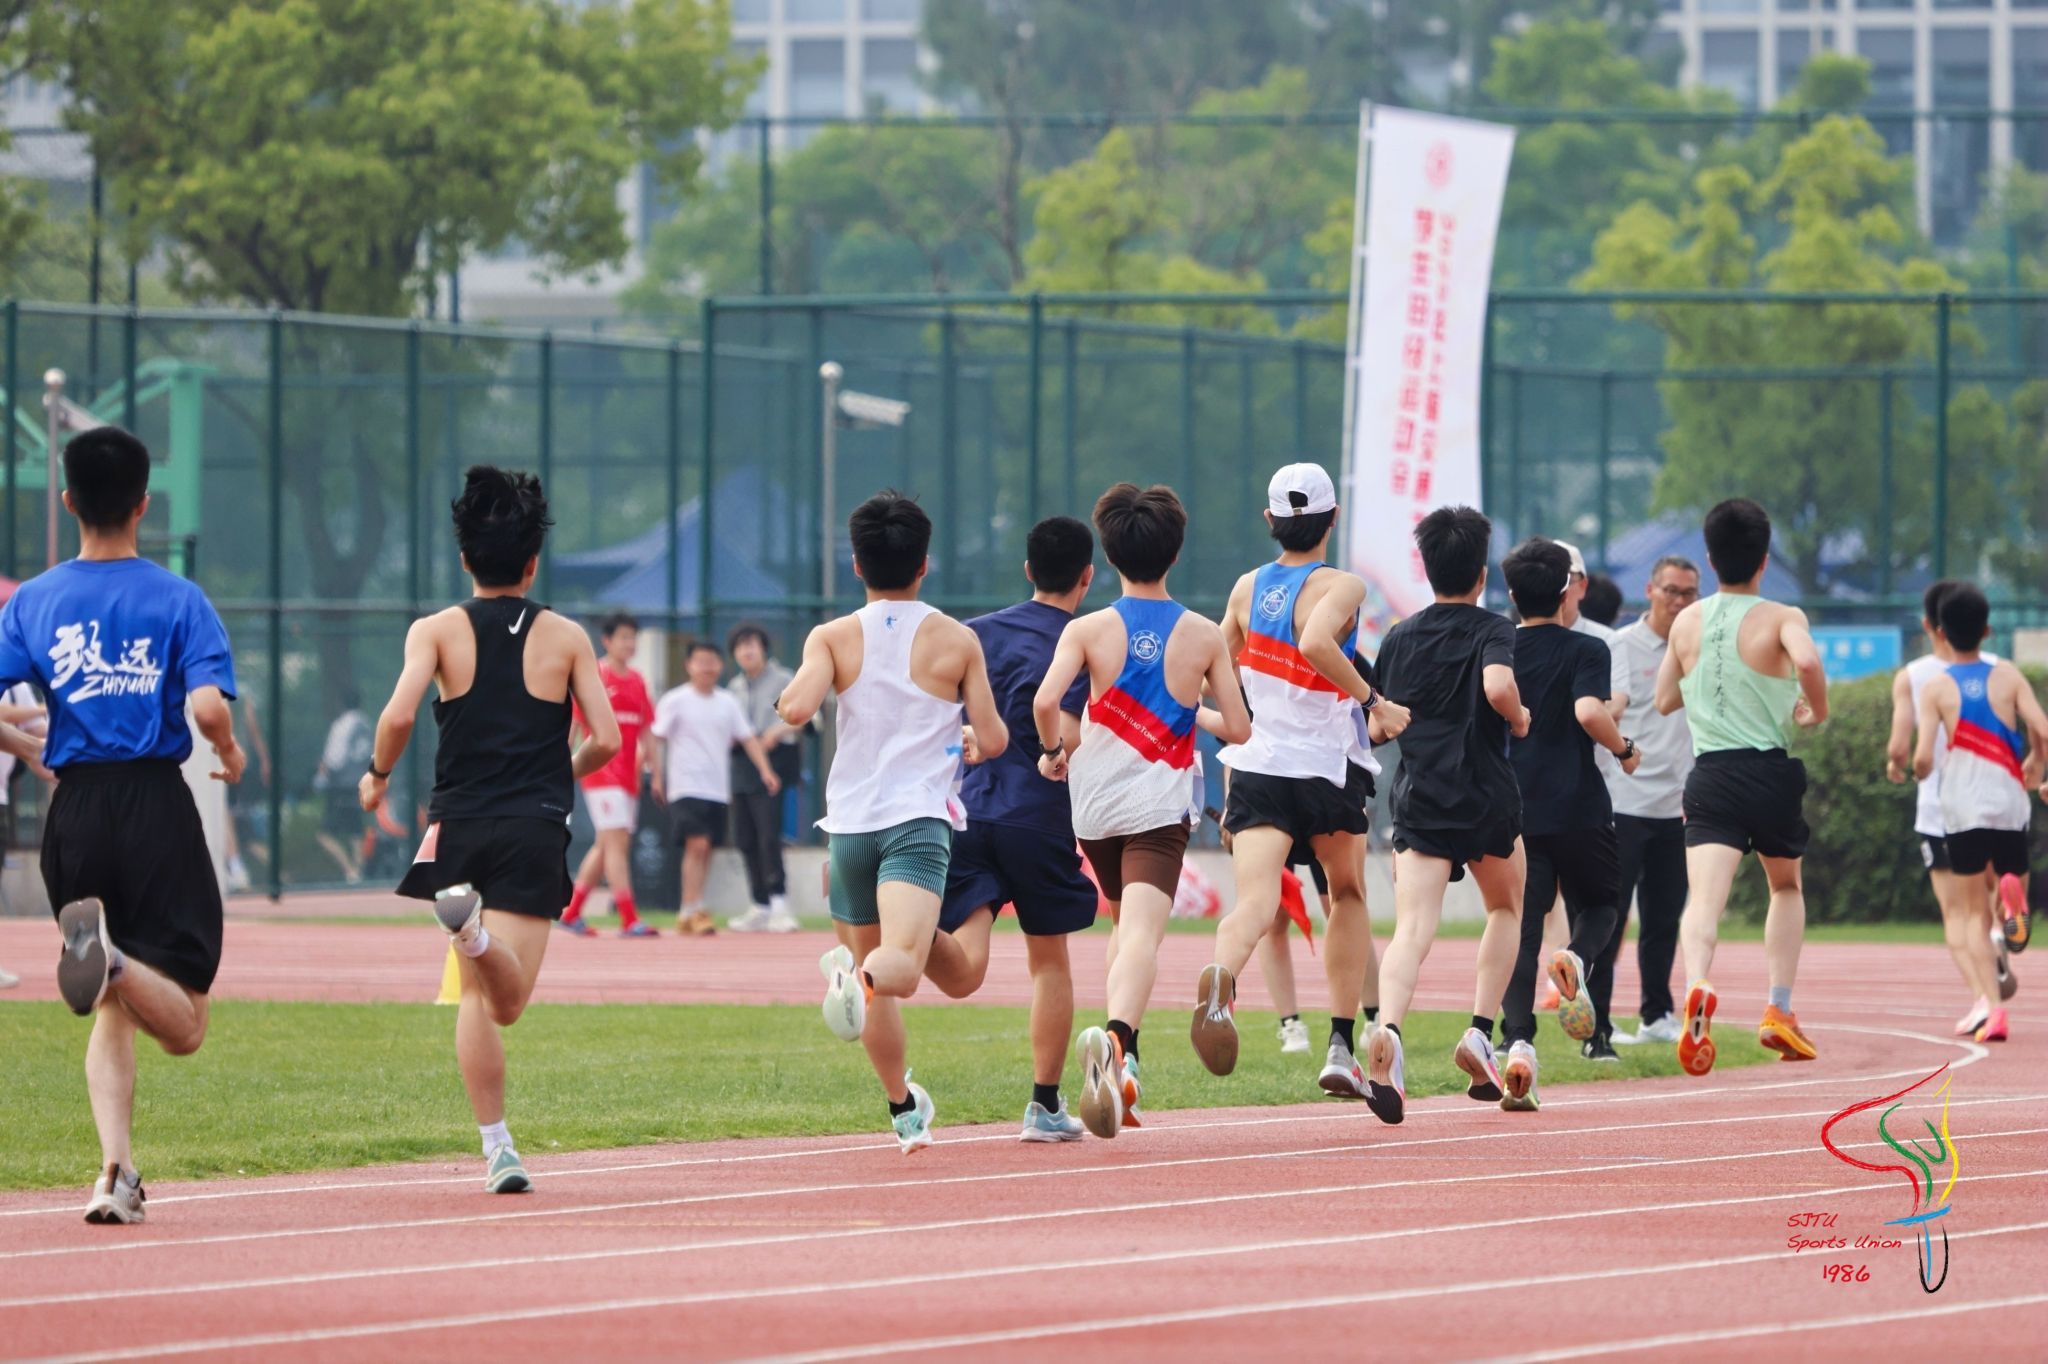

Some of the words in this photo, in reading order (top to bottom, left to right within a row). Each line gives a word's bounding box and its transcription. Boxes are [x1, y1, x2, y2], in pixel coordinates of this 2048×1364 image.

[48, 619, 162, 690] 致远
[67, 674, 159, 704] ZHIYUAN
[1140, 726, 1159, 744] TONG
